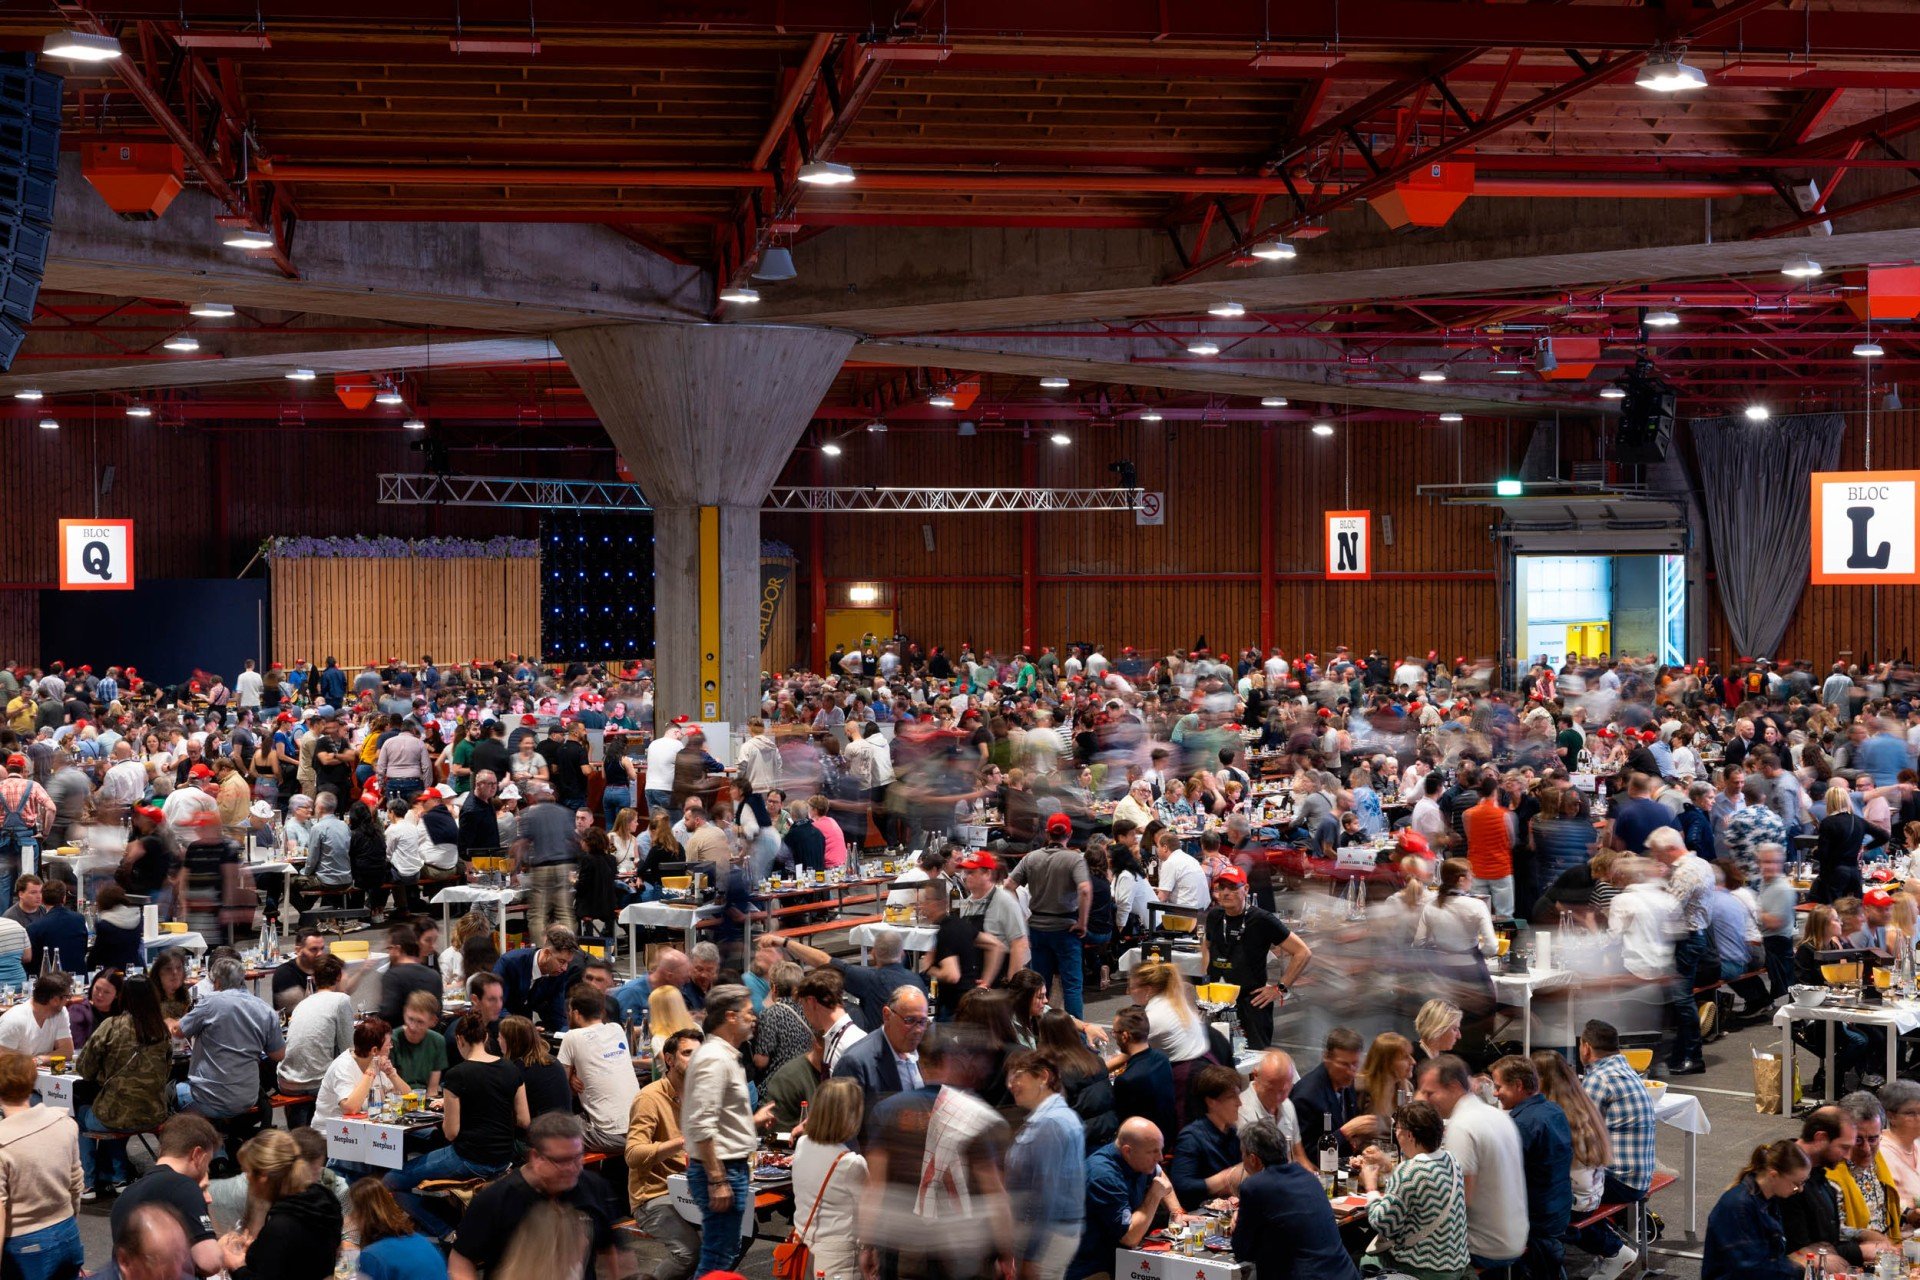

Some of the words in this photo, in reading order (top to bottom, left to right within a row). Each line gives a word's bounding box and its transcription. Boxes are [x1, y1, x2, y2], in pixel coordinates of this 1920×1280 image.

[1848, 486, 1889, 500] BLOC
[83, 528, 110, 538] BLOC
[1339, 519, 1356, 529] BLOC
[1846, 506, 1891, 570] L
[82, 540, 112, 581] Q
[1337, 531, 1359, 571] N
[760, 577, 785, 639] ALDOR
